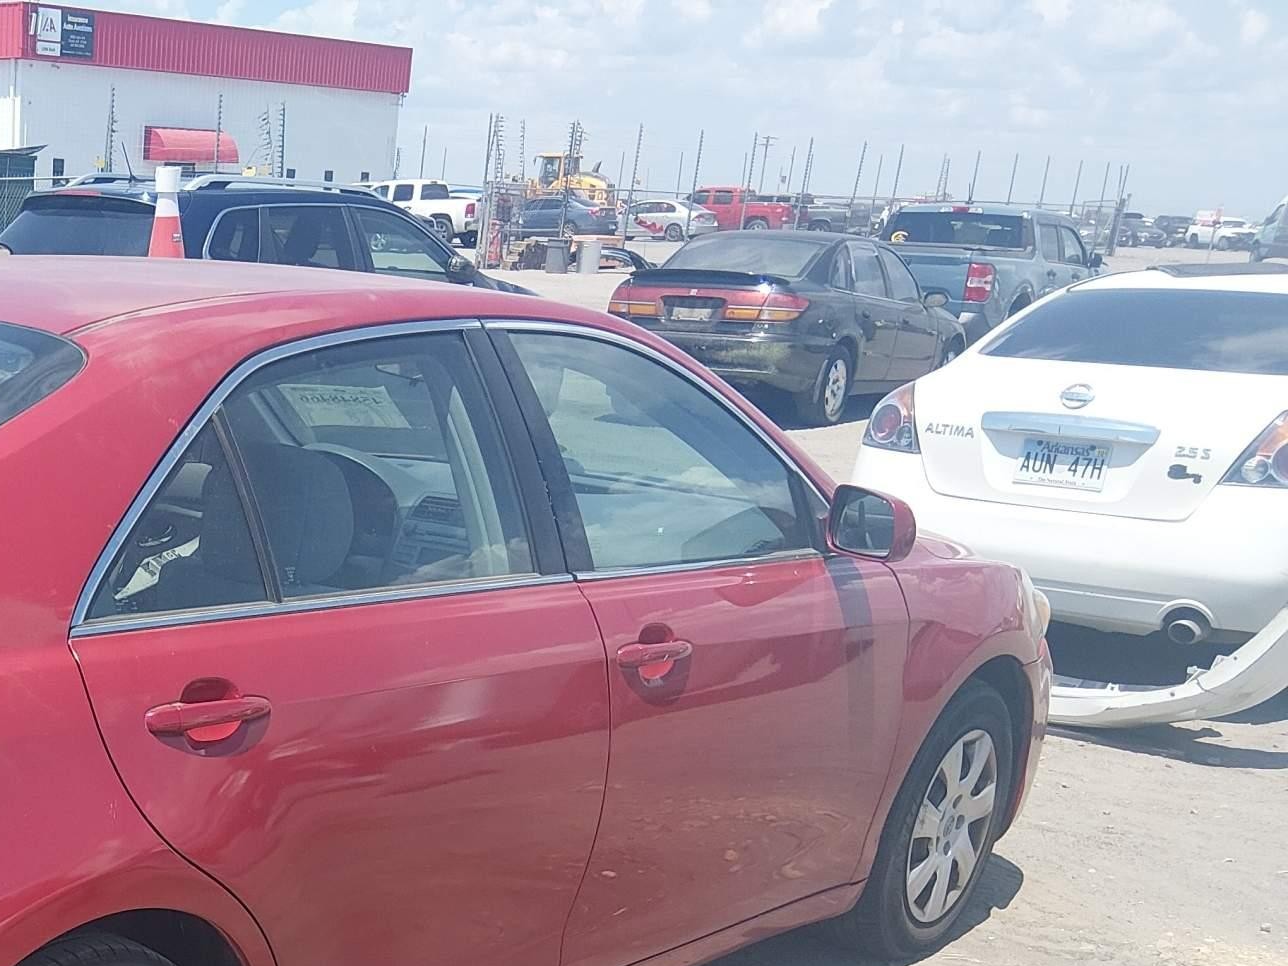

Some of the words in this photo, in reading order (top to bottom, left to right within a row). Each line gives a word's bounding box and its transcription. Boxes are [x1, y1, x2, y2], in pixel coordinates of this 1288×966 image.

[925, 422, 975, 439] ALTIMA
[1040, 440, 1091, 457] Arkansas
[1020, 451, 1058, 474] AUN
[1067, 456, 1105, 480] 47H
